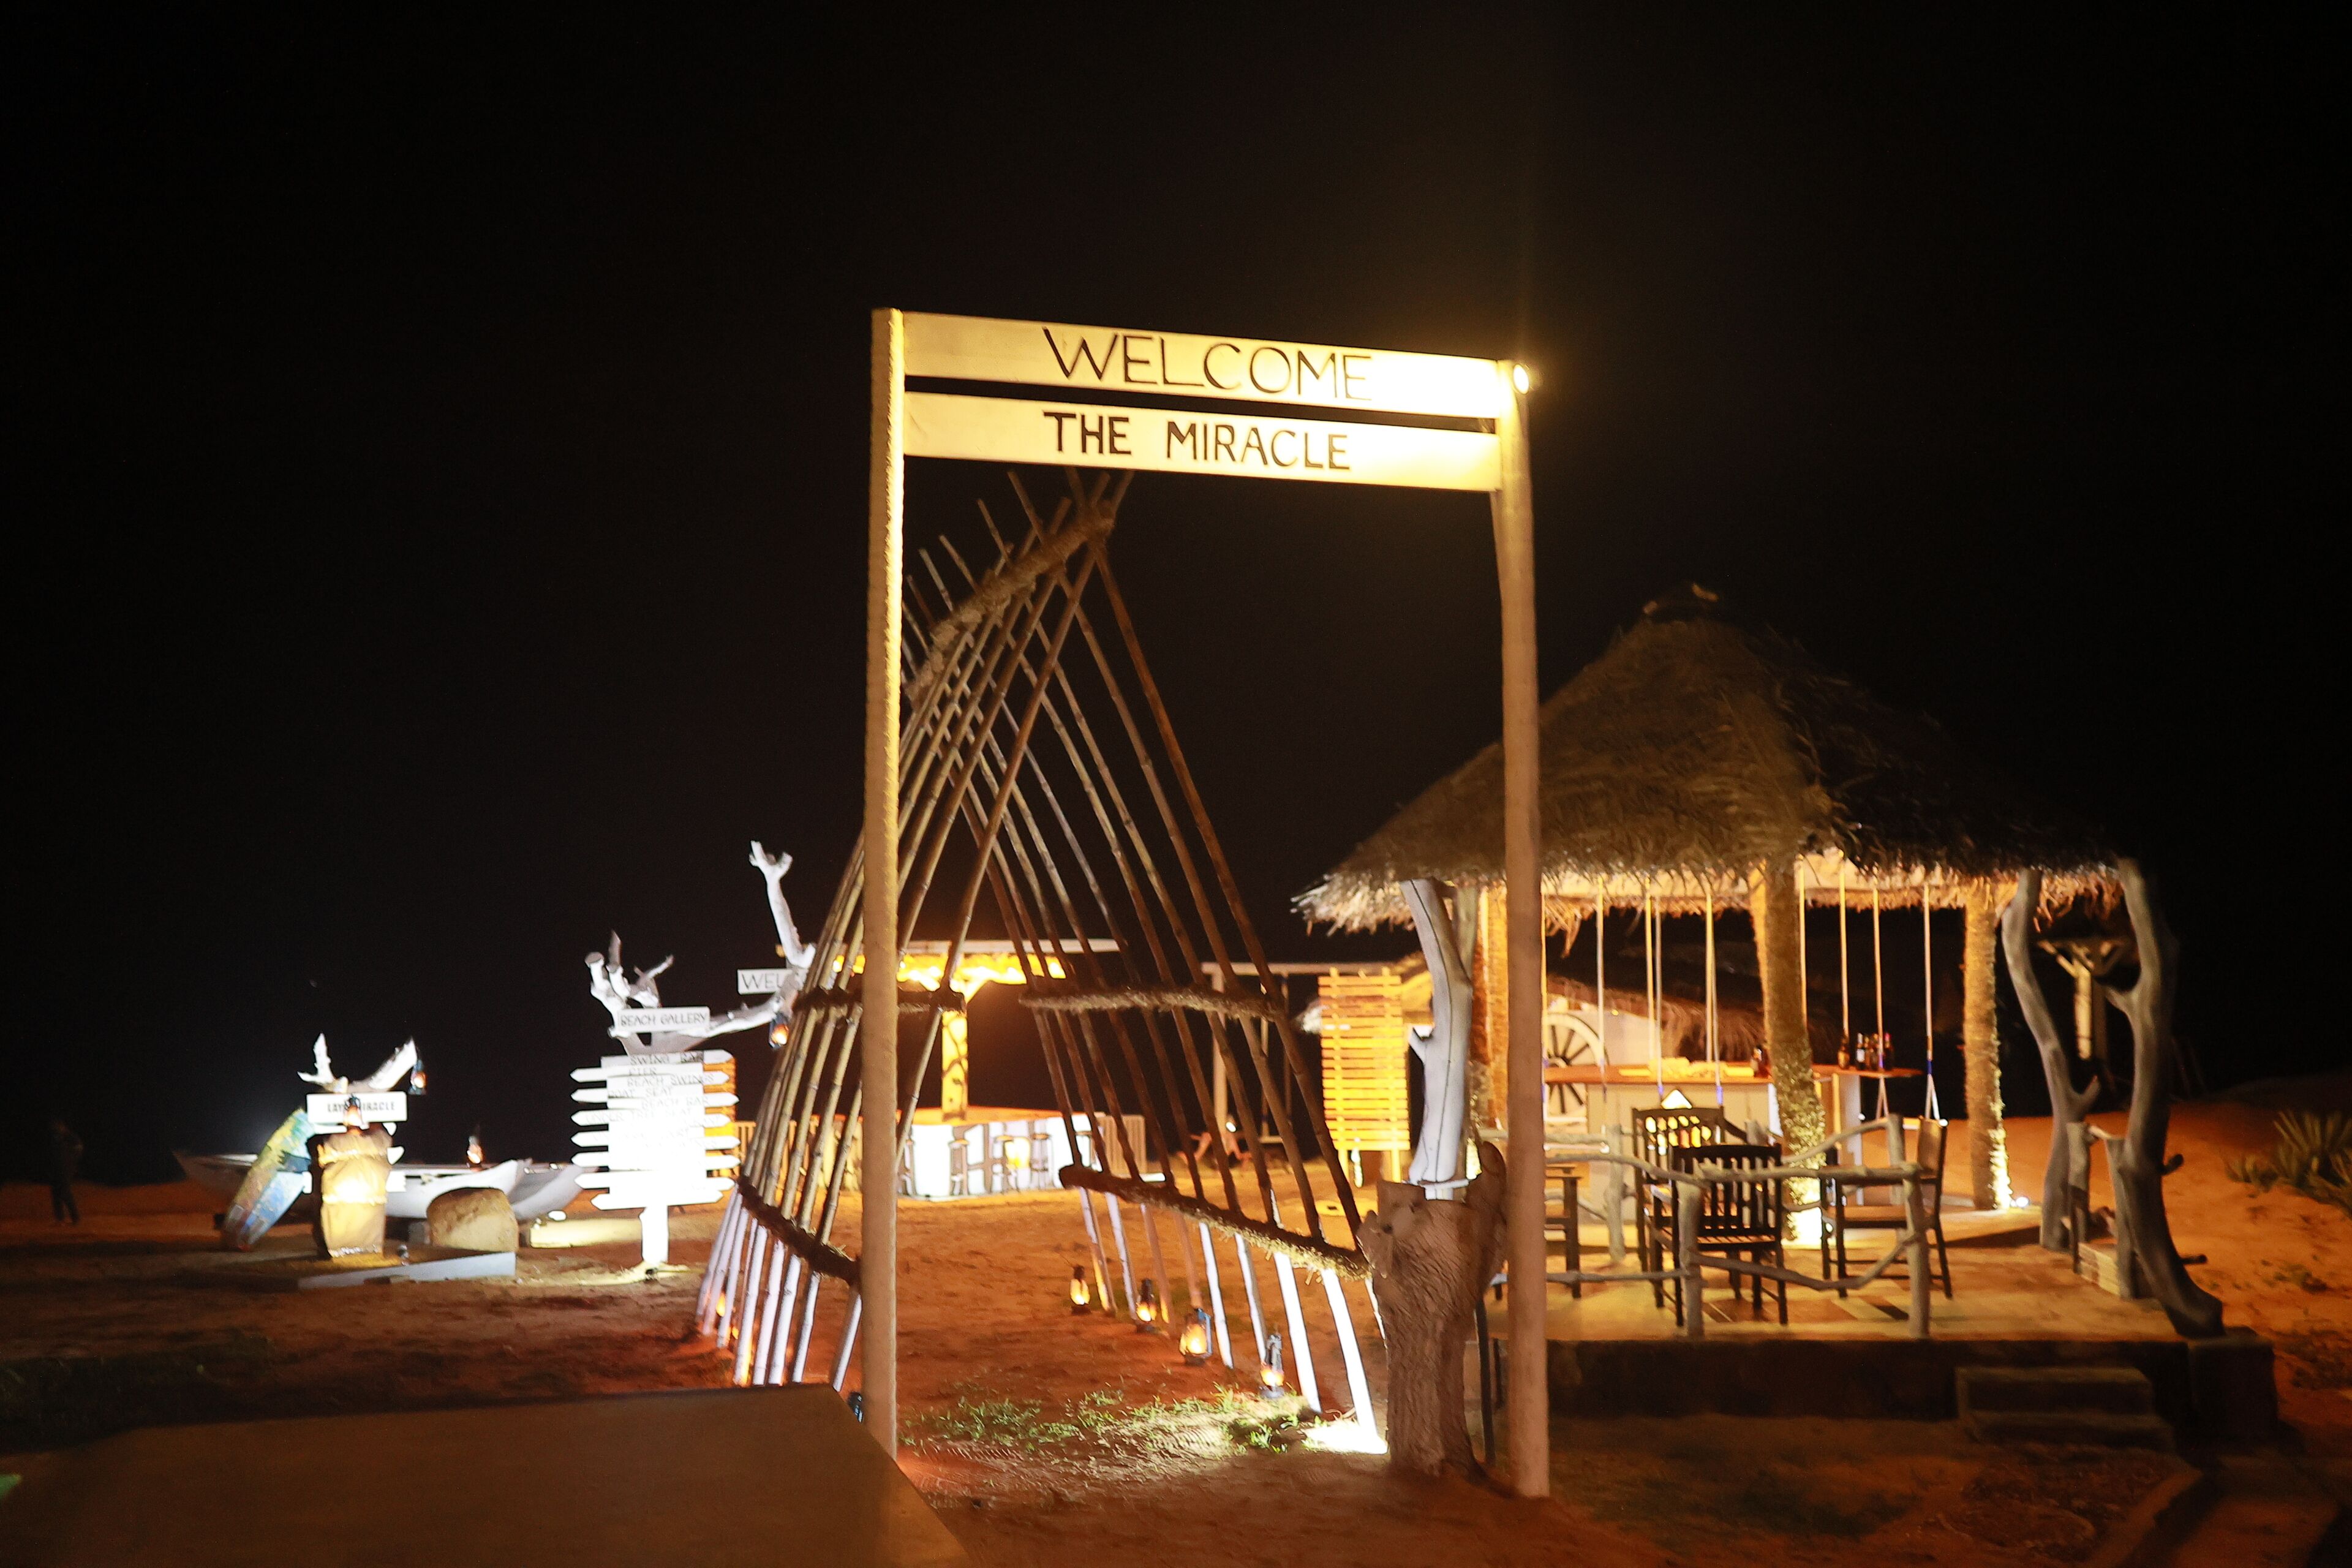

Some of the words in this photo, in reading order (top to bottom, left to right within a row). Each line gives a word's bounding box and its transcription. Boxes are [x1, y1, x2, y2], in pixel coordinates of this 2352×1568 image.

[1042, 326, 1372, 401] WELCOME
[1043, 412, 1131, 454] THE
[1167, 421, 1350, 470] MIRACLE
[741, 973, 783, 989] WEL
[620, 1015, 655, 1027] BEACH
[660, 1012, 707, 1025] GALLERY
[328, 1103, 345, 1112] LAY
[361, 1101, 395, 1112] IRACLE
